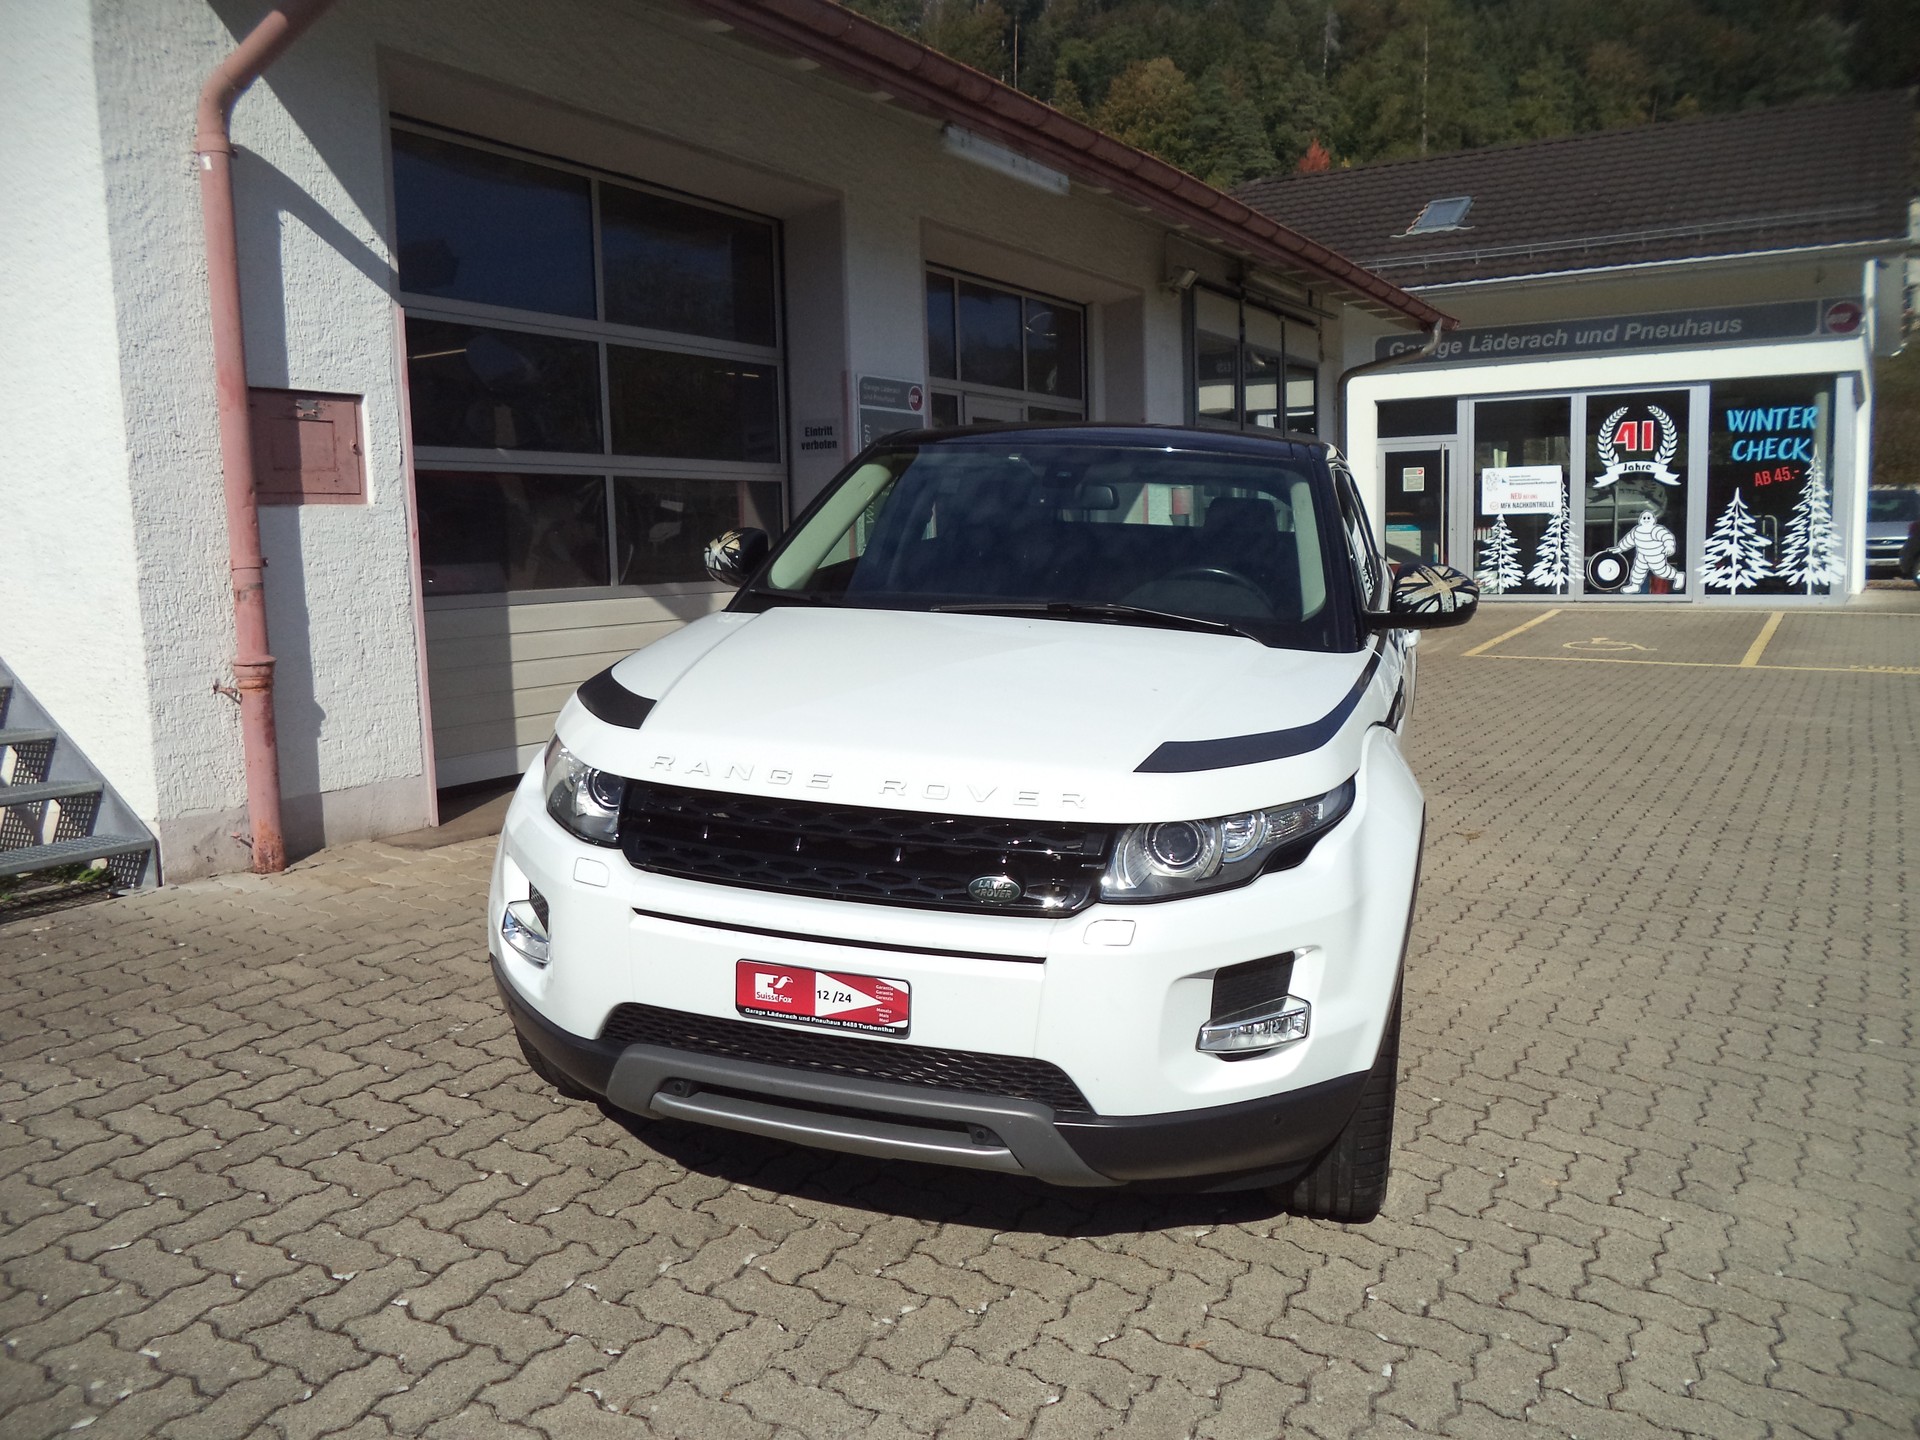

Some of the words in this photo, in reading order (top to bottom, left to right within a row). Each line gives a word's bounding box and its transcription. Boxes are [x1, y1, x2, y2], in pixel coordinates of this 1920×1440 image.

[1469, 329, 1567, 353] Läderach
[1575, 323, 1619, 345] und
[1625, 317, 1742, 341] Pneuhaus
[1726, 406, 1819, 433] WINTER
[804, 426, 833, 437] Eintritt
[801, 439, 837, 450] verboten
[1731, 437, 1811, 463] CHECK
[1623, 463, 1652, 472] Jahre
[1754, 470, 1771, 487] AB
[1774, 466, 1800, 482] 45.-
[649, 755, 833, 790] RANGE
[878, 780, 1087, 809] ROVER
[978, 879, 1005, 889] LAND
[980, 888, 1013, 898] ROVER
[817, 990, 829, 1000] 12
[745, 1007, 766, 1016] Garage
[767, 1010, 797, 1021] Läderach
[811, 1017, 841, 1027] Pneuhaus
[858, 1022, 896, 1034] Turbenthal
